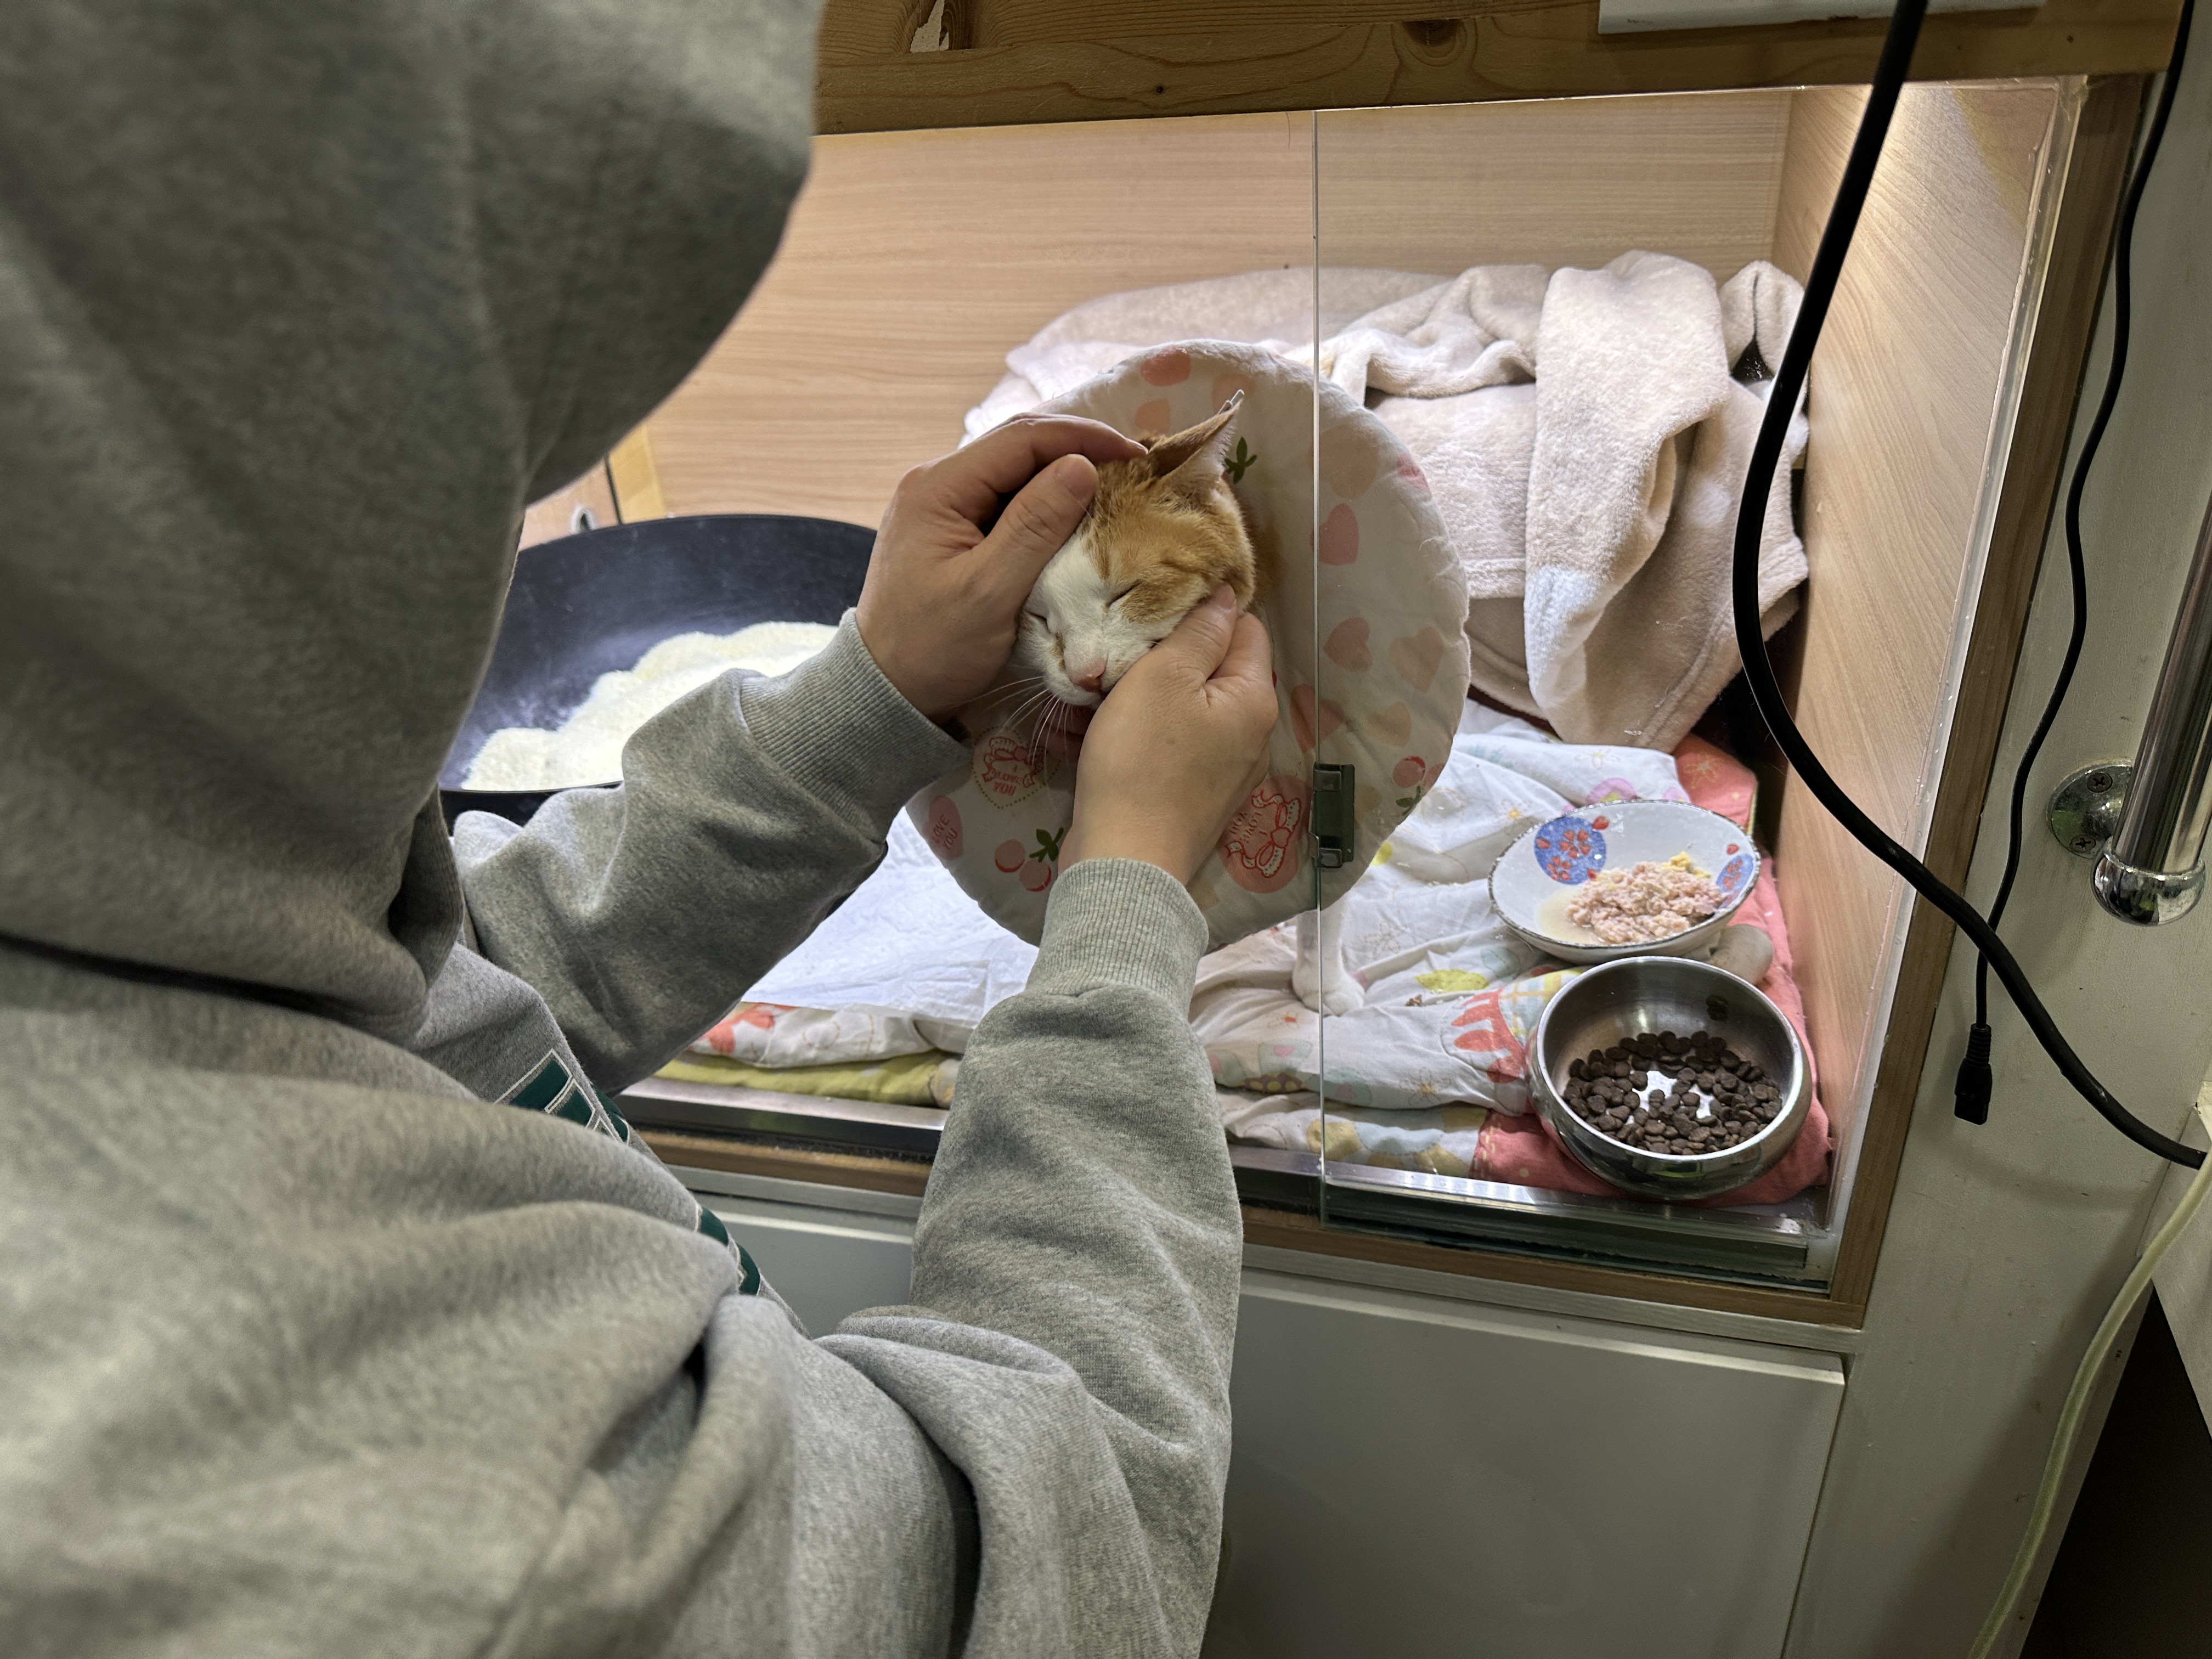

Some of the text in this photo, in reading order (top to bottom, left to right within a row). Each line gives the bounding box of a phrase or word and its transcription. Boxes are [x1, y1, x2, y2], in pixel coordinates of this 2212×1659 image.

[992, 781, 1017, 796] YOU
[932, 814, 950, 844] LOVE
[943, 827, 958, 850] YOU
